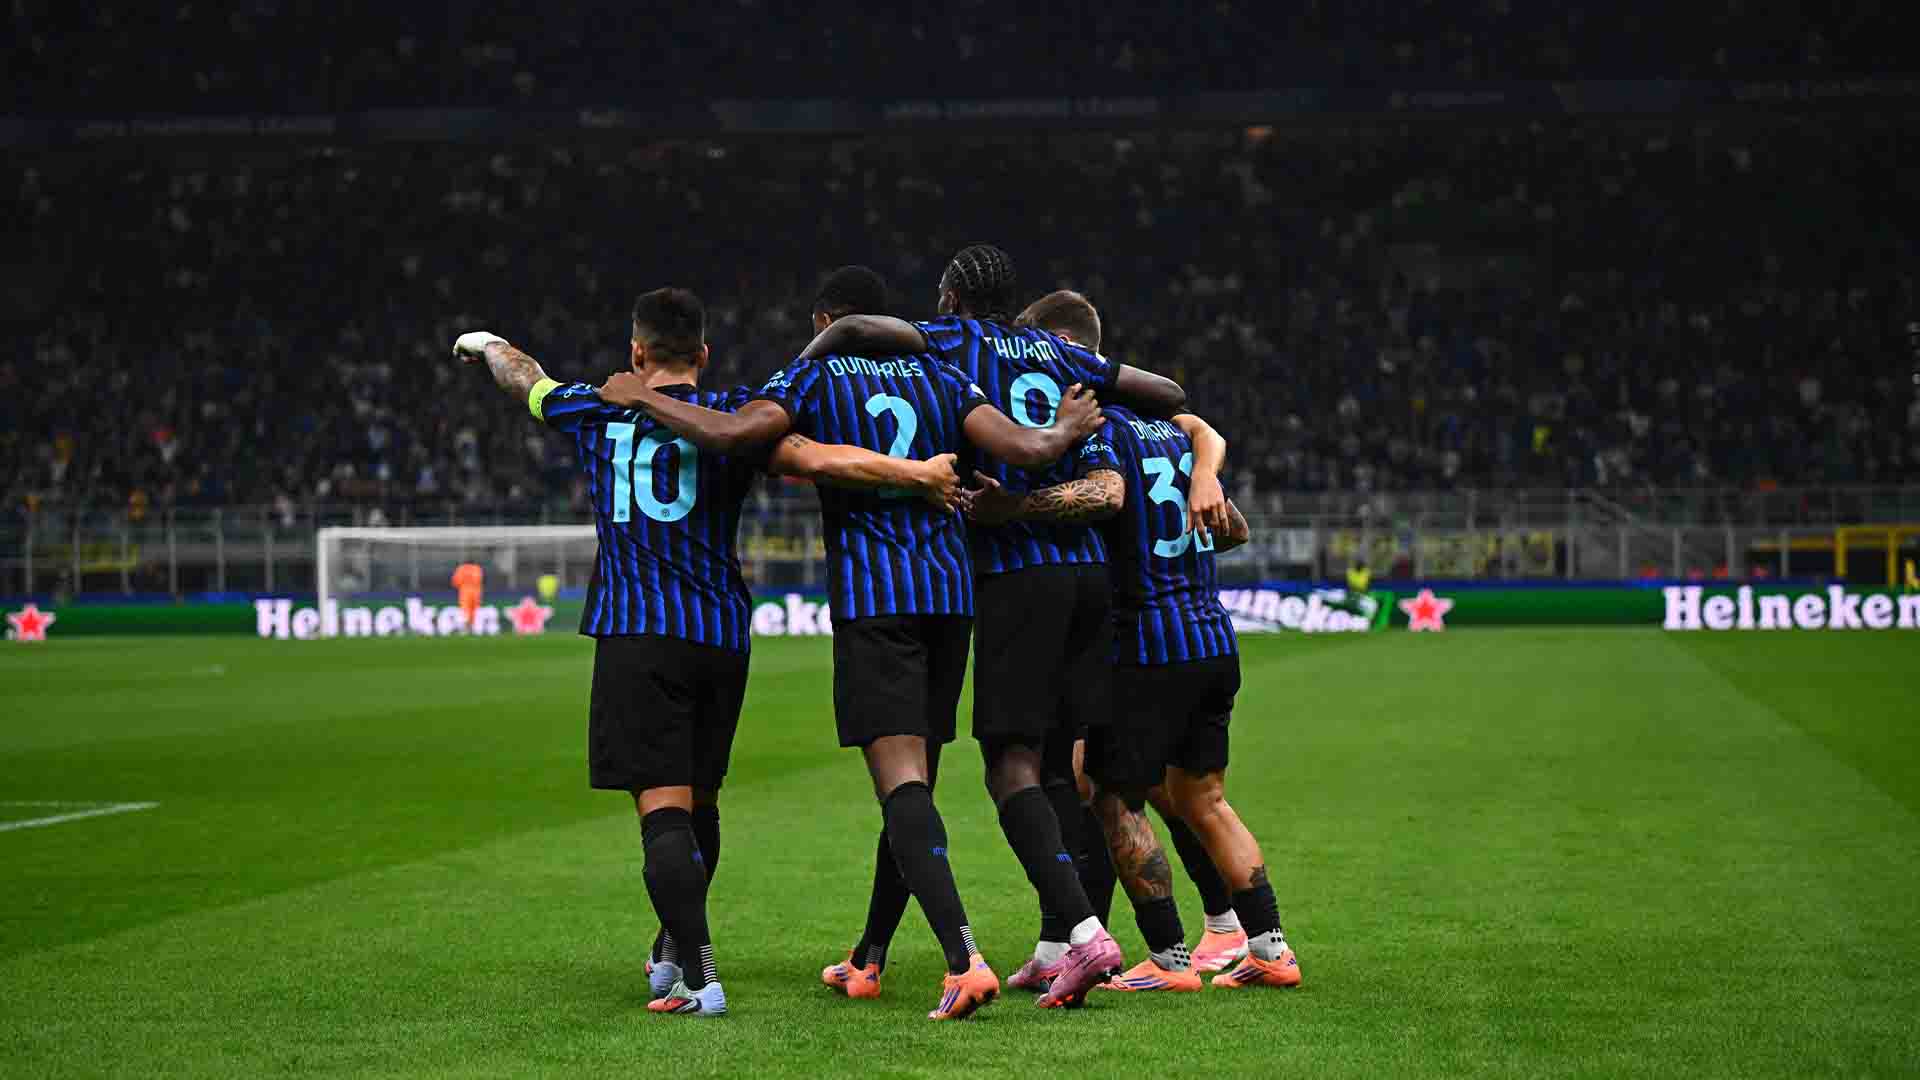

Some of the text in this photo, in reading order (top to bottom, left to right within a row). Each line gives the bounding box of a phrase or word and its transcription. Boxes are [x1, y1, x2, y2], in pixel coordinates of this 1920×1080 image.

[865, 392, 918, 459] 2
[605, 422, 697, 522] 10
[254, 597, 500, 639] Heineken
[1663, 585, 1920, 631] Heineken
